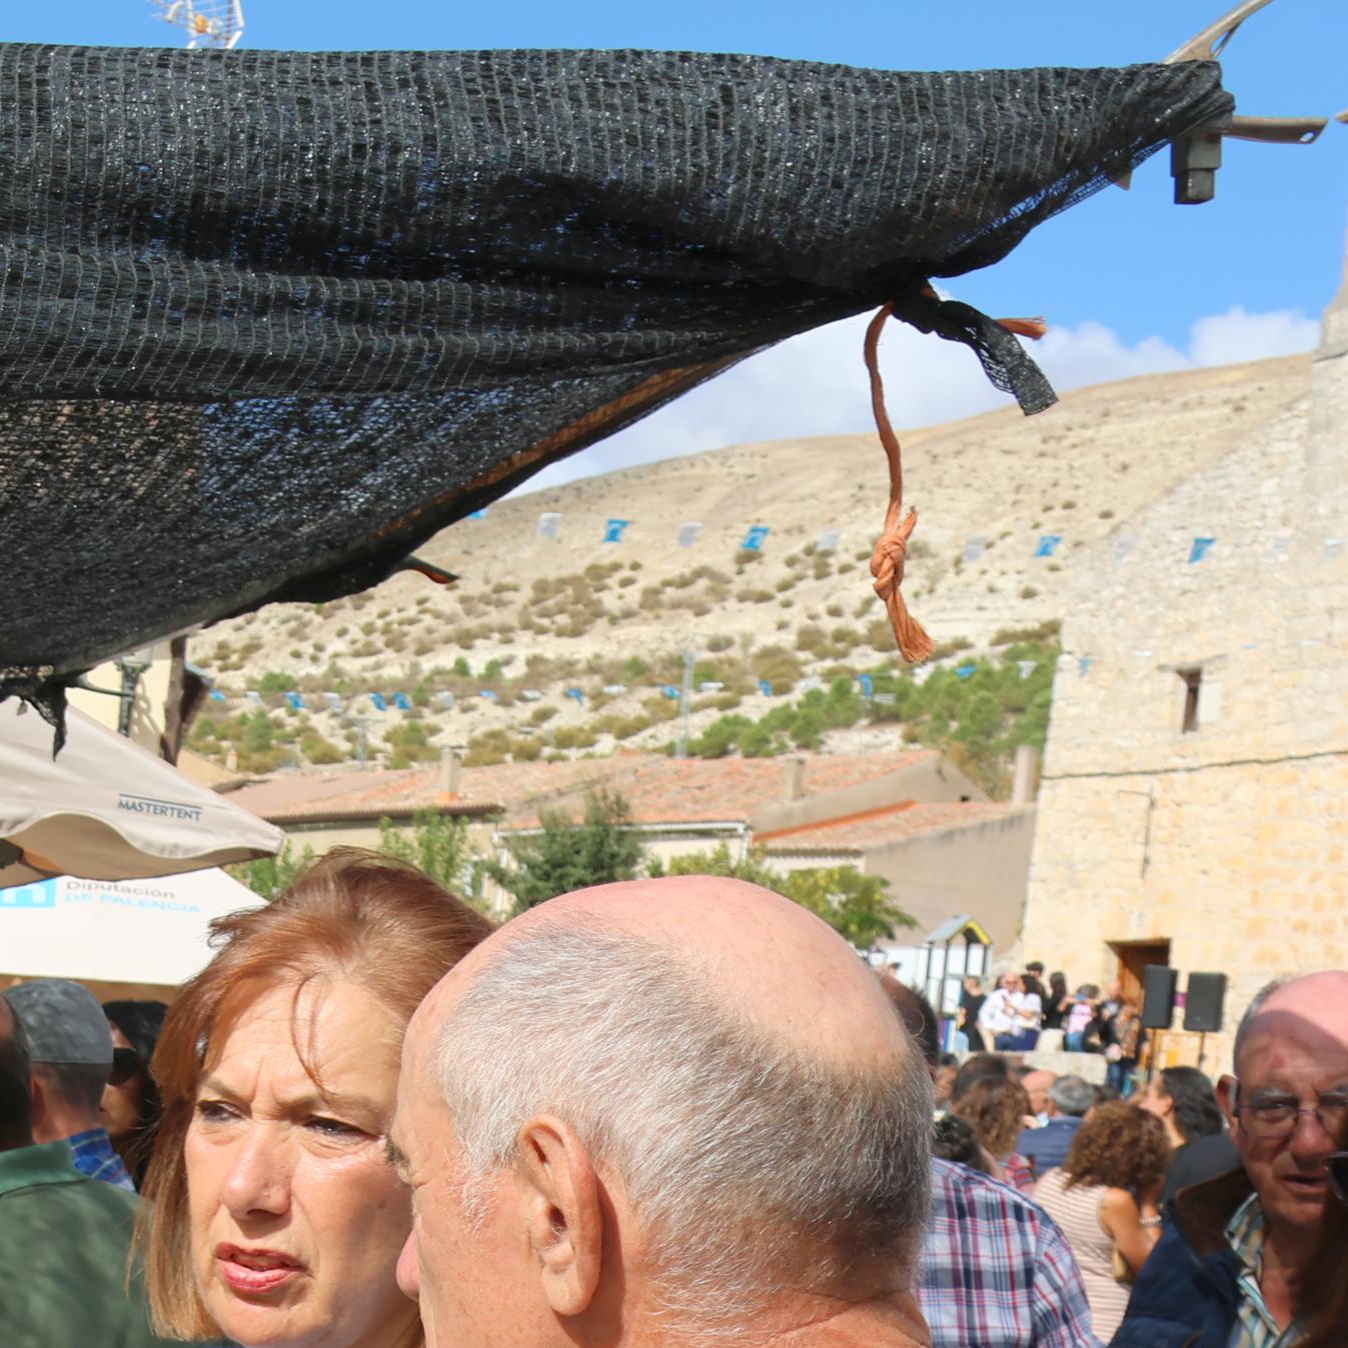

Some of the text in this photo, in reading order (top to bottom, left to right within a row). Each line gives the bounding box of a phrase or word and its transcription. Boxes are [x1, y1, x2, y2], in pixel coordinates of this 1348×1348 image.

[117, 799, 203, 822] MASTERTENT
[65, 880, 176, 900] Diputación
[65, 893, 202, 913] DE PALENCIA
